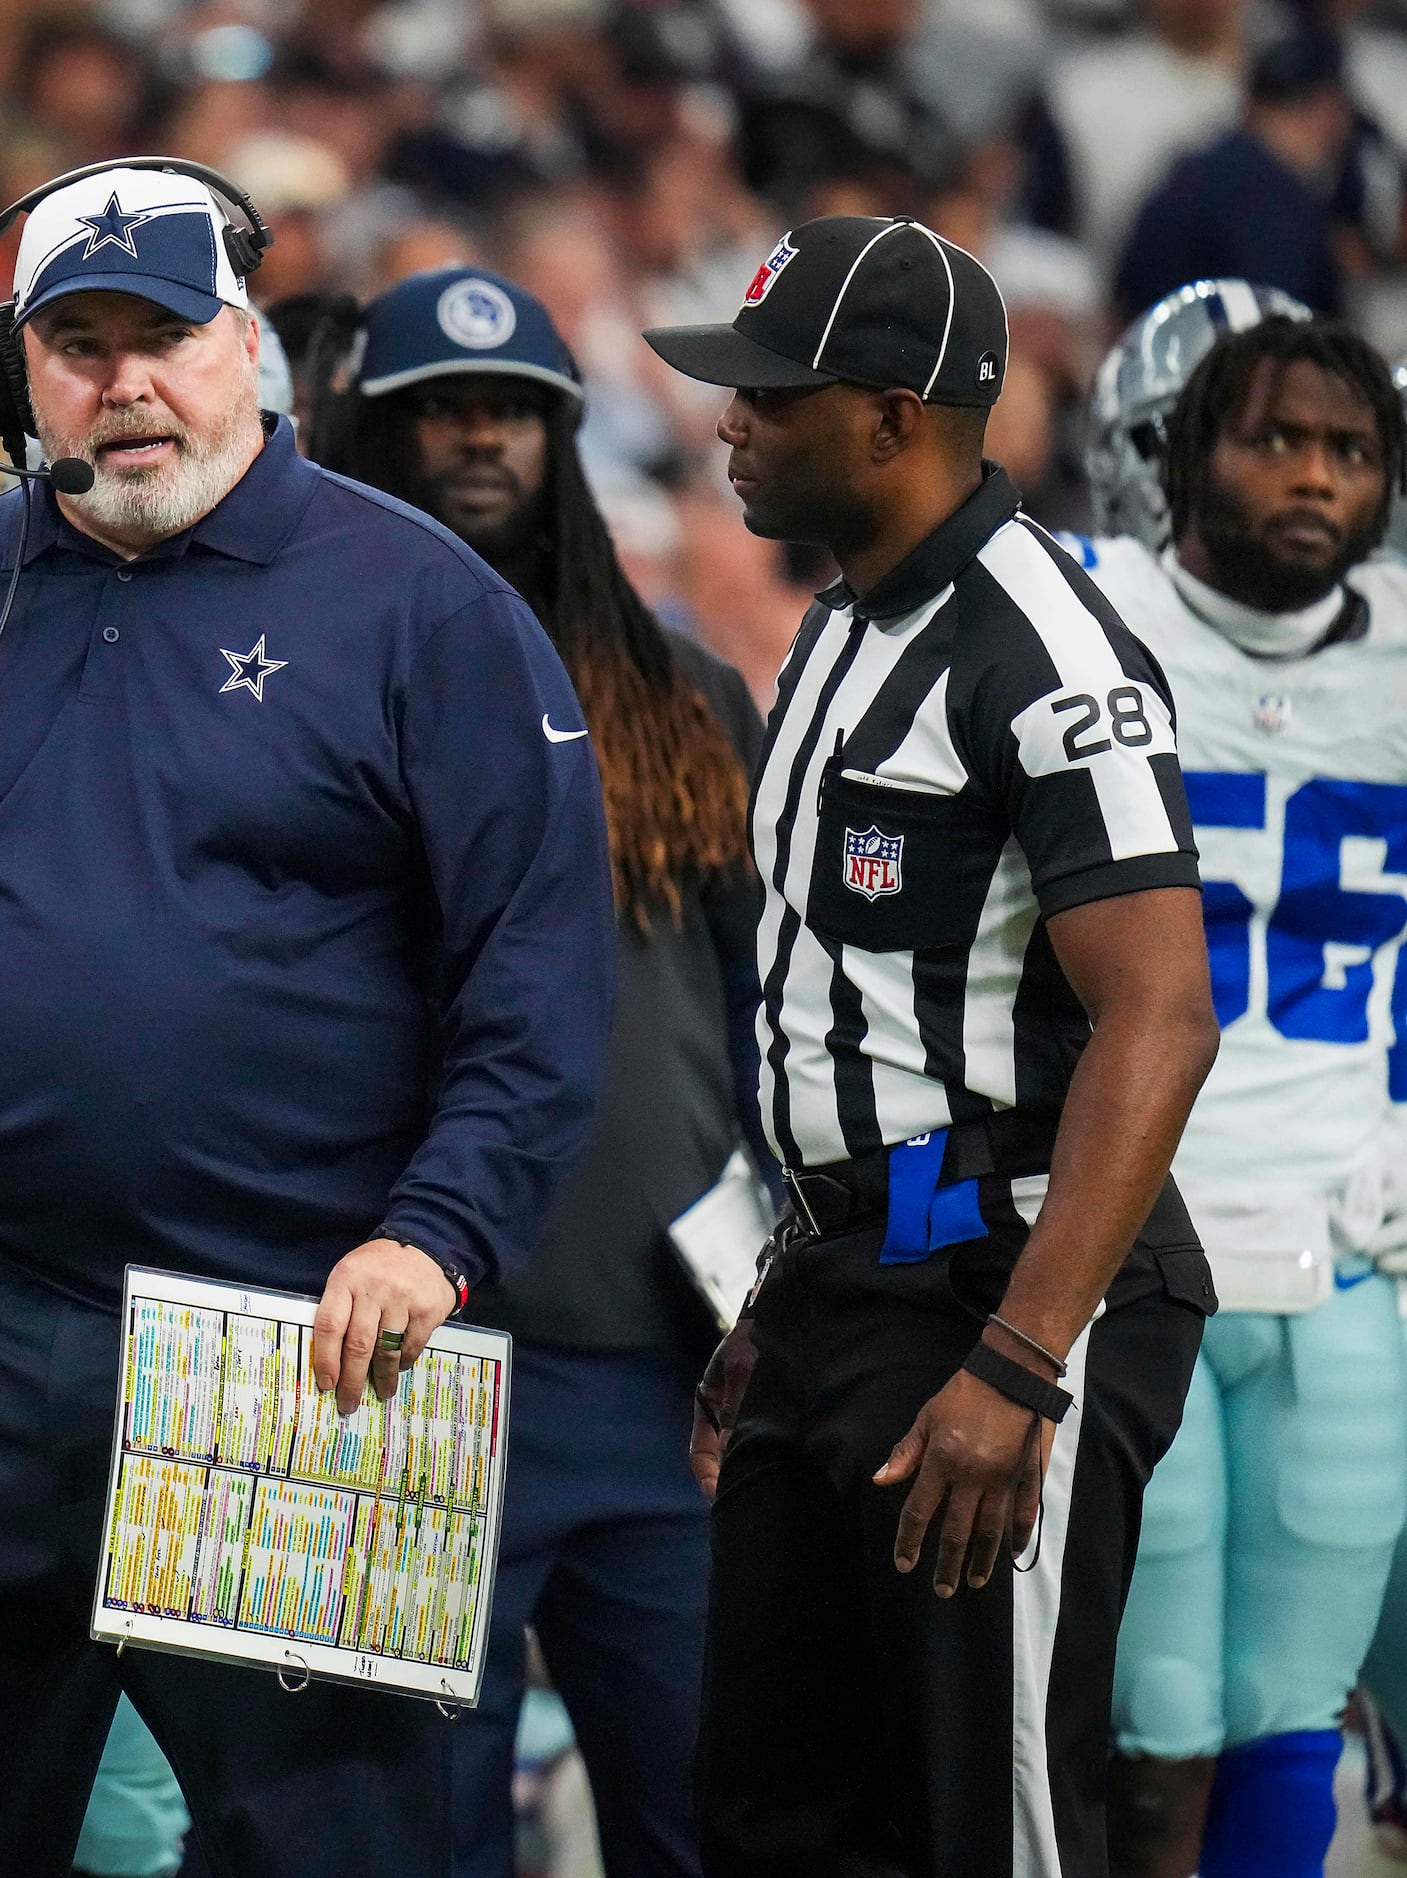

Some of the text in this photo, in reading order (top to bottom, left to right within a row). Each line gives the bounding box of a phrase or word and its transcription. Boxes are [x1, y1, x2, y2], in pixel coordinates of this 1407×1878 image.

[978, 361, 996, 382] BL
[1051, 686, 1153, 762] 28
[848, 856, 895, 889] NFL
